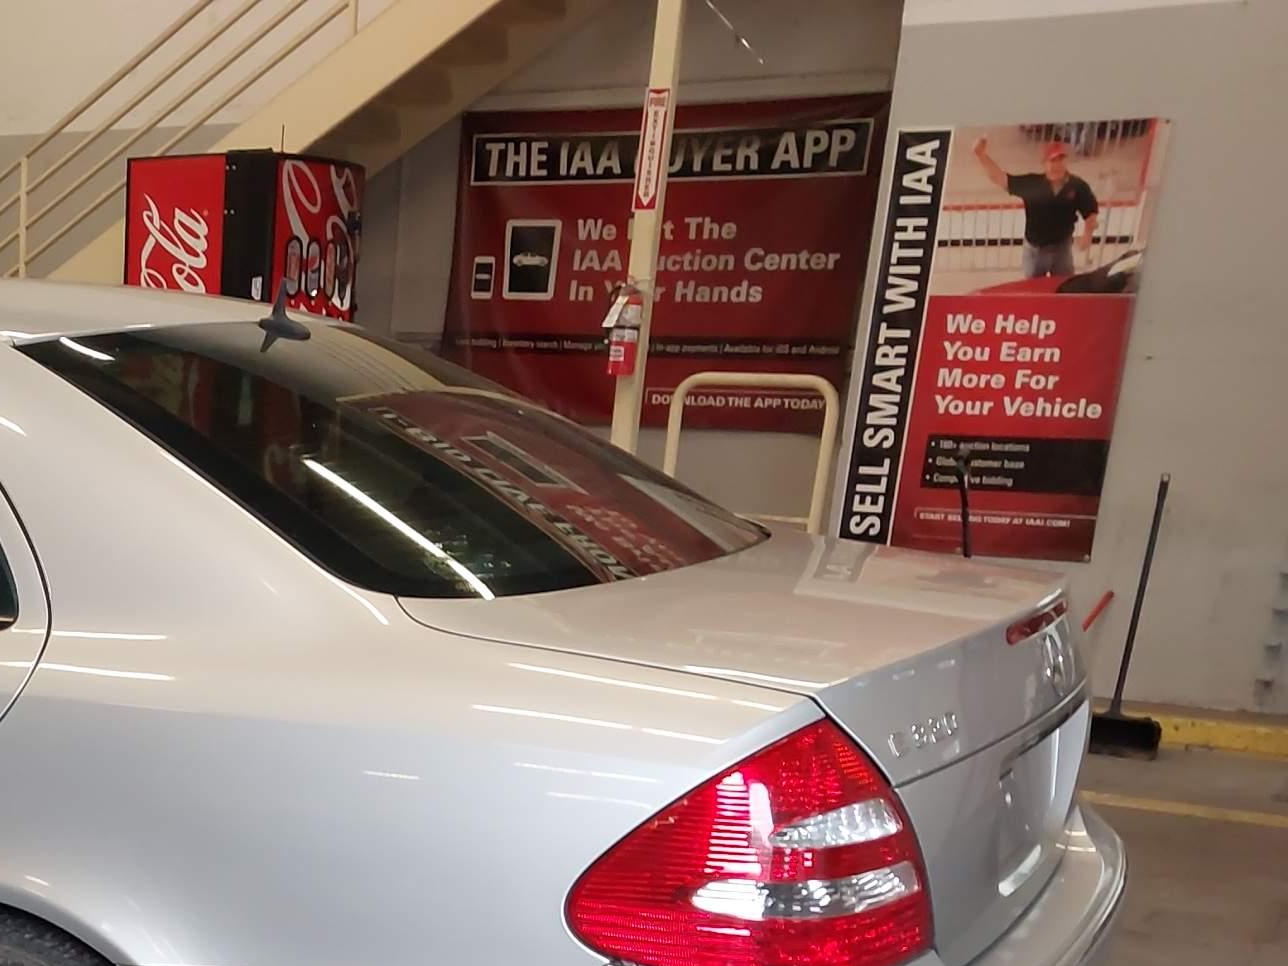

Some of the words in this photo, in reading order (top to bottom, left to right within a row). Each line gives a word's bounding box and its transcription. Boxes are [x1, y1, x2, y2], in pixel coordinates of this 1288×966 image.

[485, 141, 549, 177] THE
[559, 140, 622, 176] IAA
[634, 134, 762, 173] UYER
[770, 128, 856, 170] APP
[899, 139, 941, 204] IAA
[577, 218, 617, 241] We
[685, 217, 737, 241] The
[573, 249, 623, 272] IAA
[657, 249, 735, 272] uction
[744, 247, 841, 272] Center
[882, 217, 929, 314] WITH
[569, 280, 594, 301] In
[674, 280, 763, 303] Hands
[946, 313, 986, 335] We
[994, 314, 1056, 339] Help
[943, 340, 991, 362] You
[999, 341, 1061, 363] Earn
[863, 321, 912, 449] SMART
[937, 368, 1006, 389] More
[1014, 369, 1060, 390] For
[651, 393, 726, 407] DONLOAD
[728, 396, 752, 408] THE
[753, 397, 782, 409] APP
[934, 394, 995, 416] Your
[1003, 396, 1103, 419] Vehicle
[935, 455, 958, 467] Glob
[970, 459, 1003, 468] ustomer
[849, 458, 891, 537] SELL
[947, 513, 983, 524] SELING
